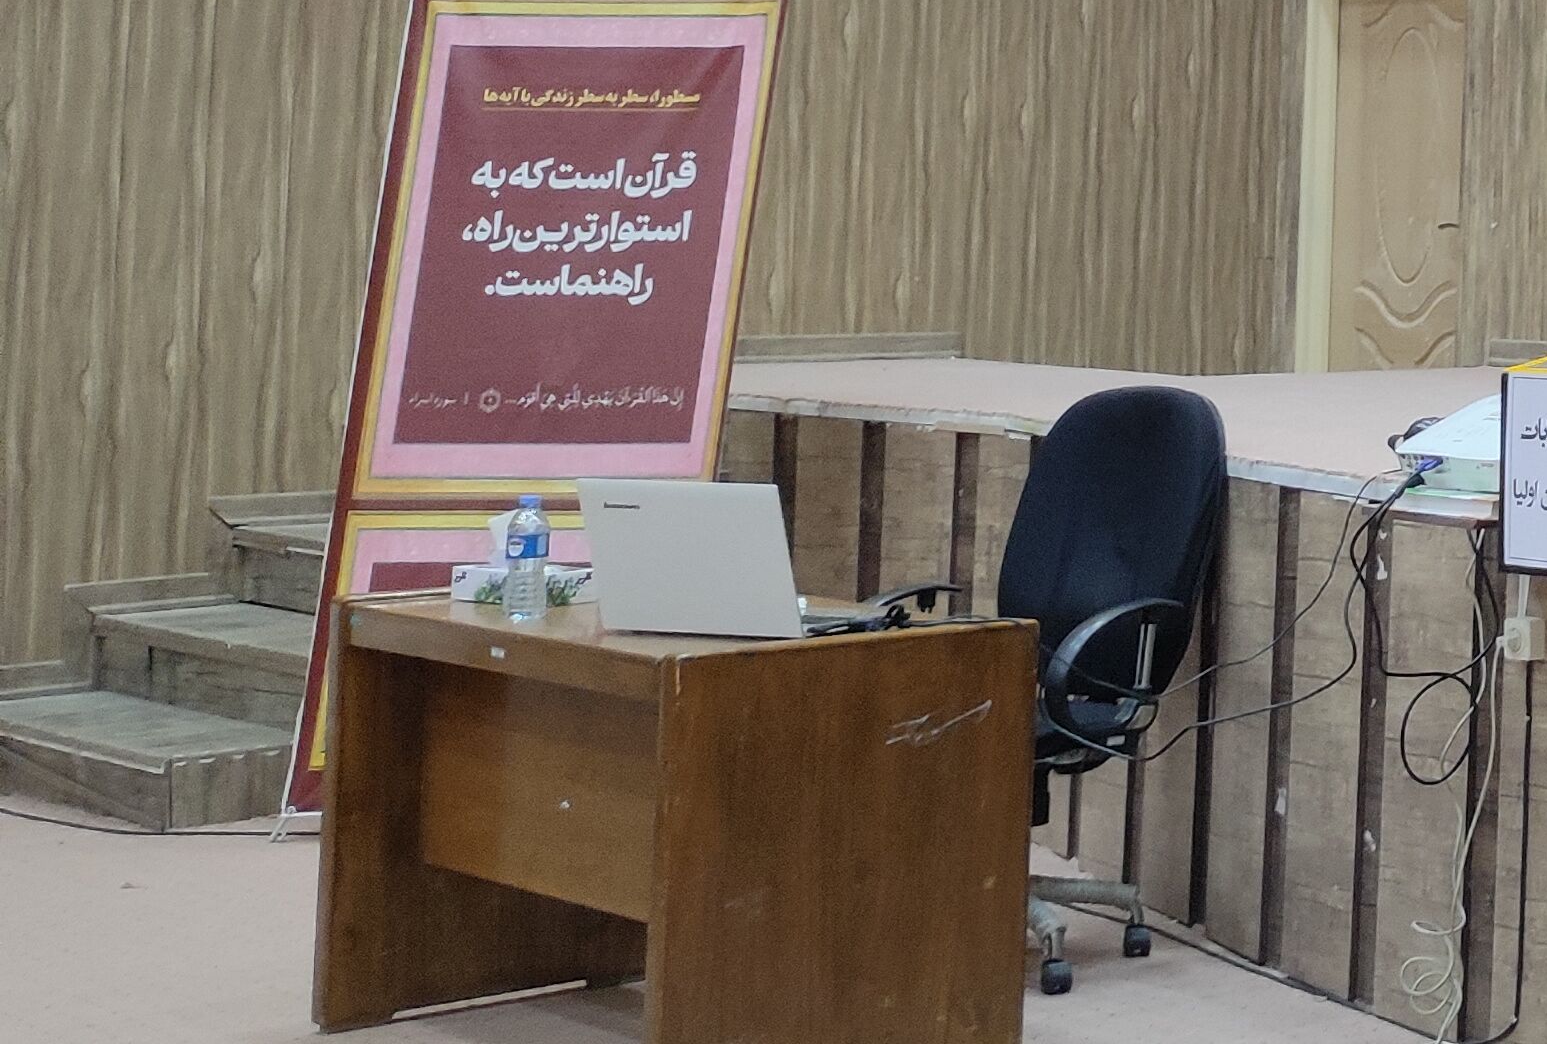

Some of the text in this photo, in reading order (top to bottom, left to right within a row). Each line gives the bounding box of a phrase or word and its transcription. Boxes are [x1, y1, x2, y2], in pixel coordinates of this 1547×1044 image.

[530, 87, 575, 107] زندگی
[574, 88, 604, 107] سطر
[605, 89, 619, 107] به
[617, 88, 649, 108] سطر
[470, 150, 698, 199] قرآن است که به
[1512, 477, 1539, 507] اولیا
